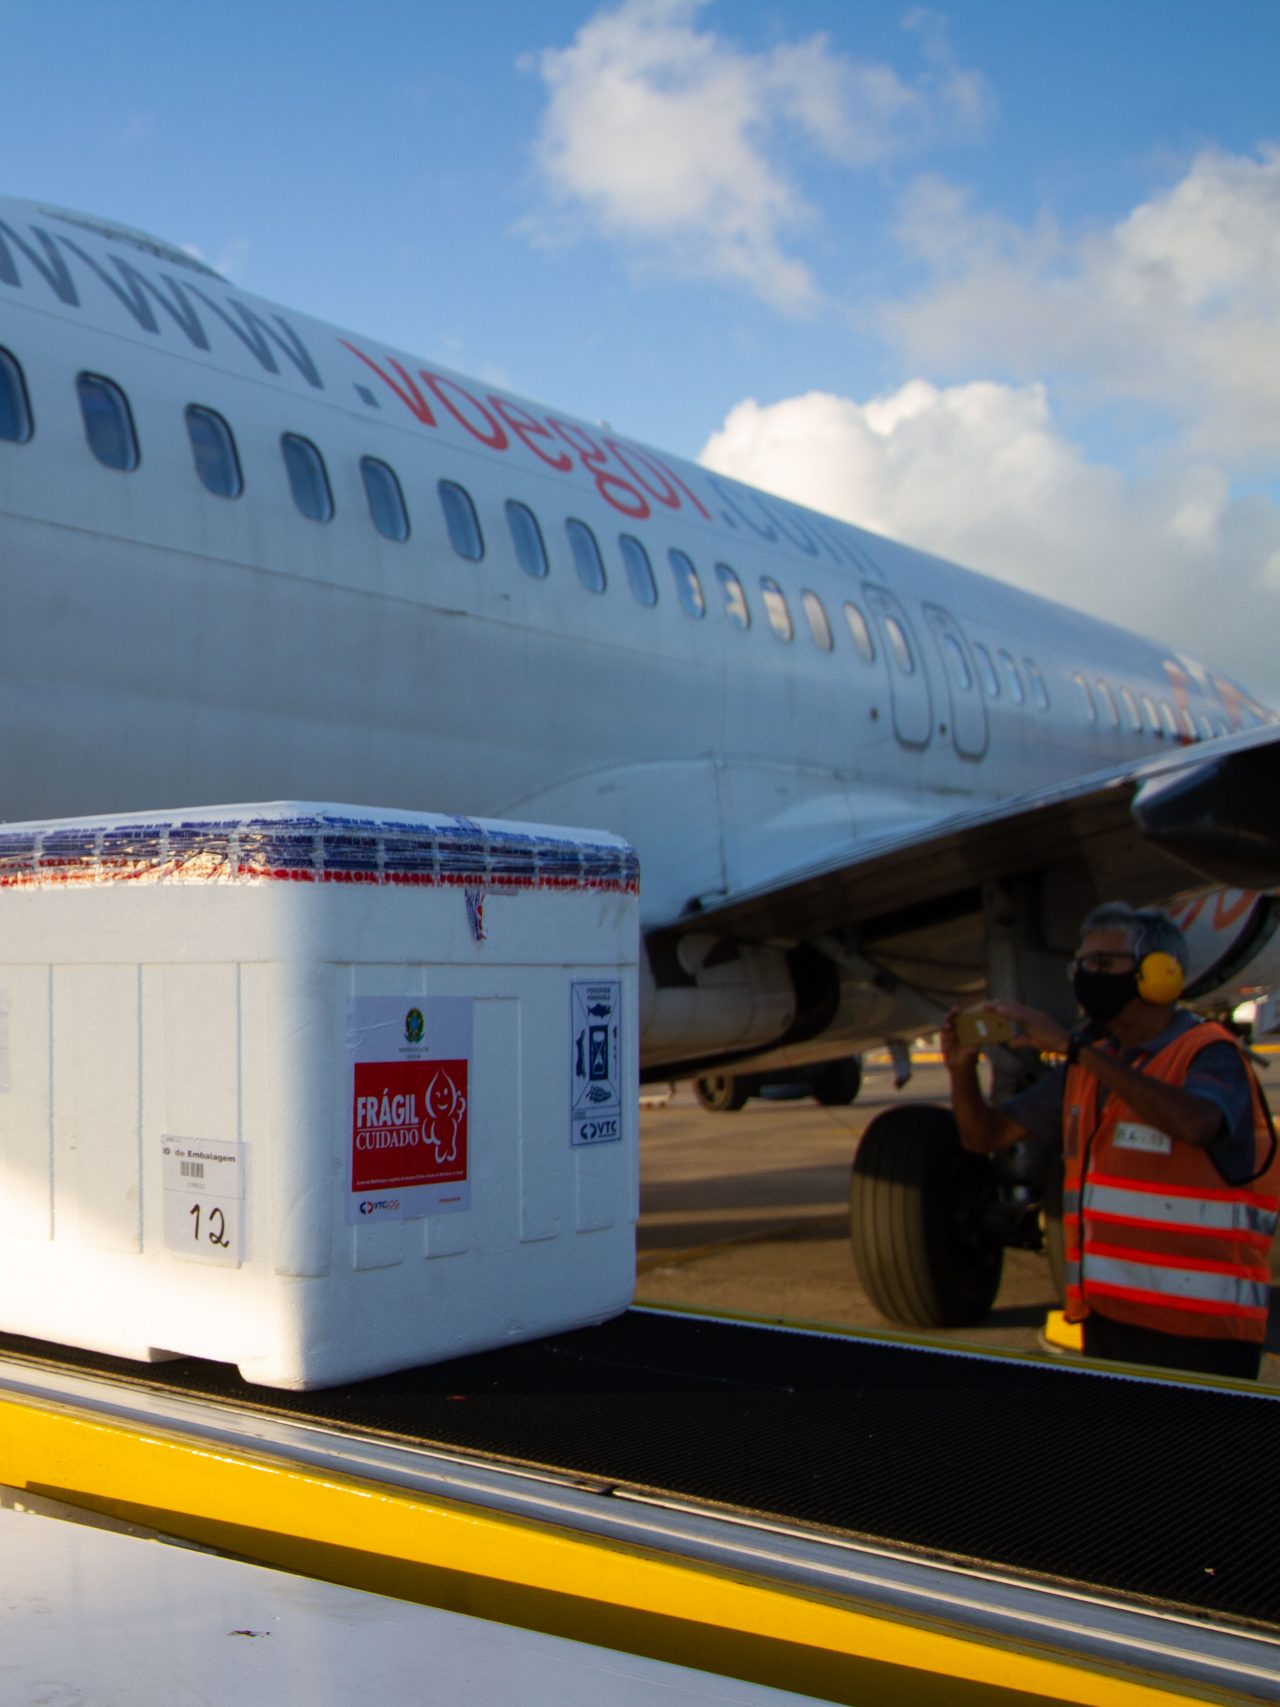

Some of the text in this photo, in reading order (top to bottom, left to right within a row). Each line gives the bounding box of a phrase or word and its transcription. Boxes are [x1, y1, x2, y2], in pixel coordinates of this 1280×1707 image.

[357, 1087, 419, 1128] FRÁGIL
[356, 1128, 419, 1151] CUIDADO
[187, 1150, 236, 1163] Embalagem
[190, 1203, 230, 1249] 12
